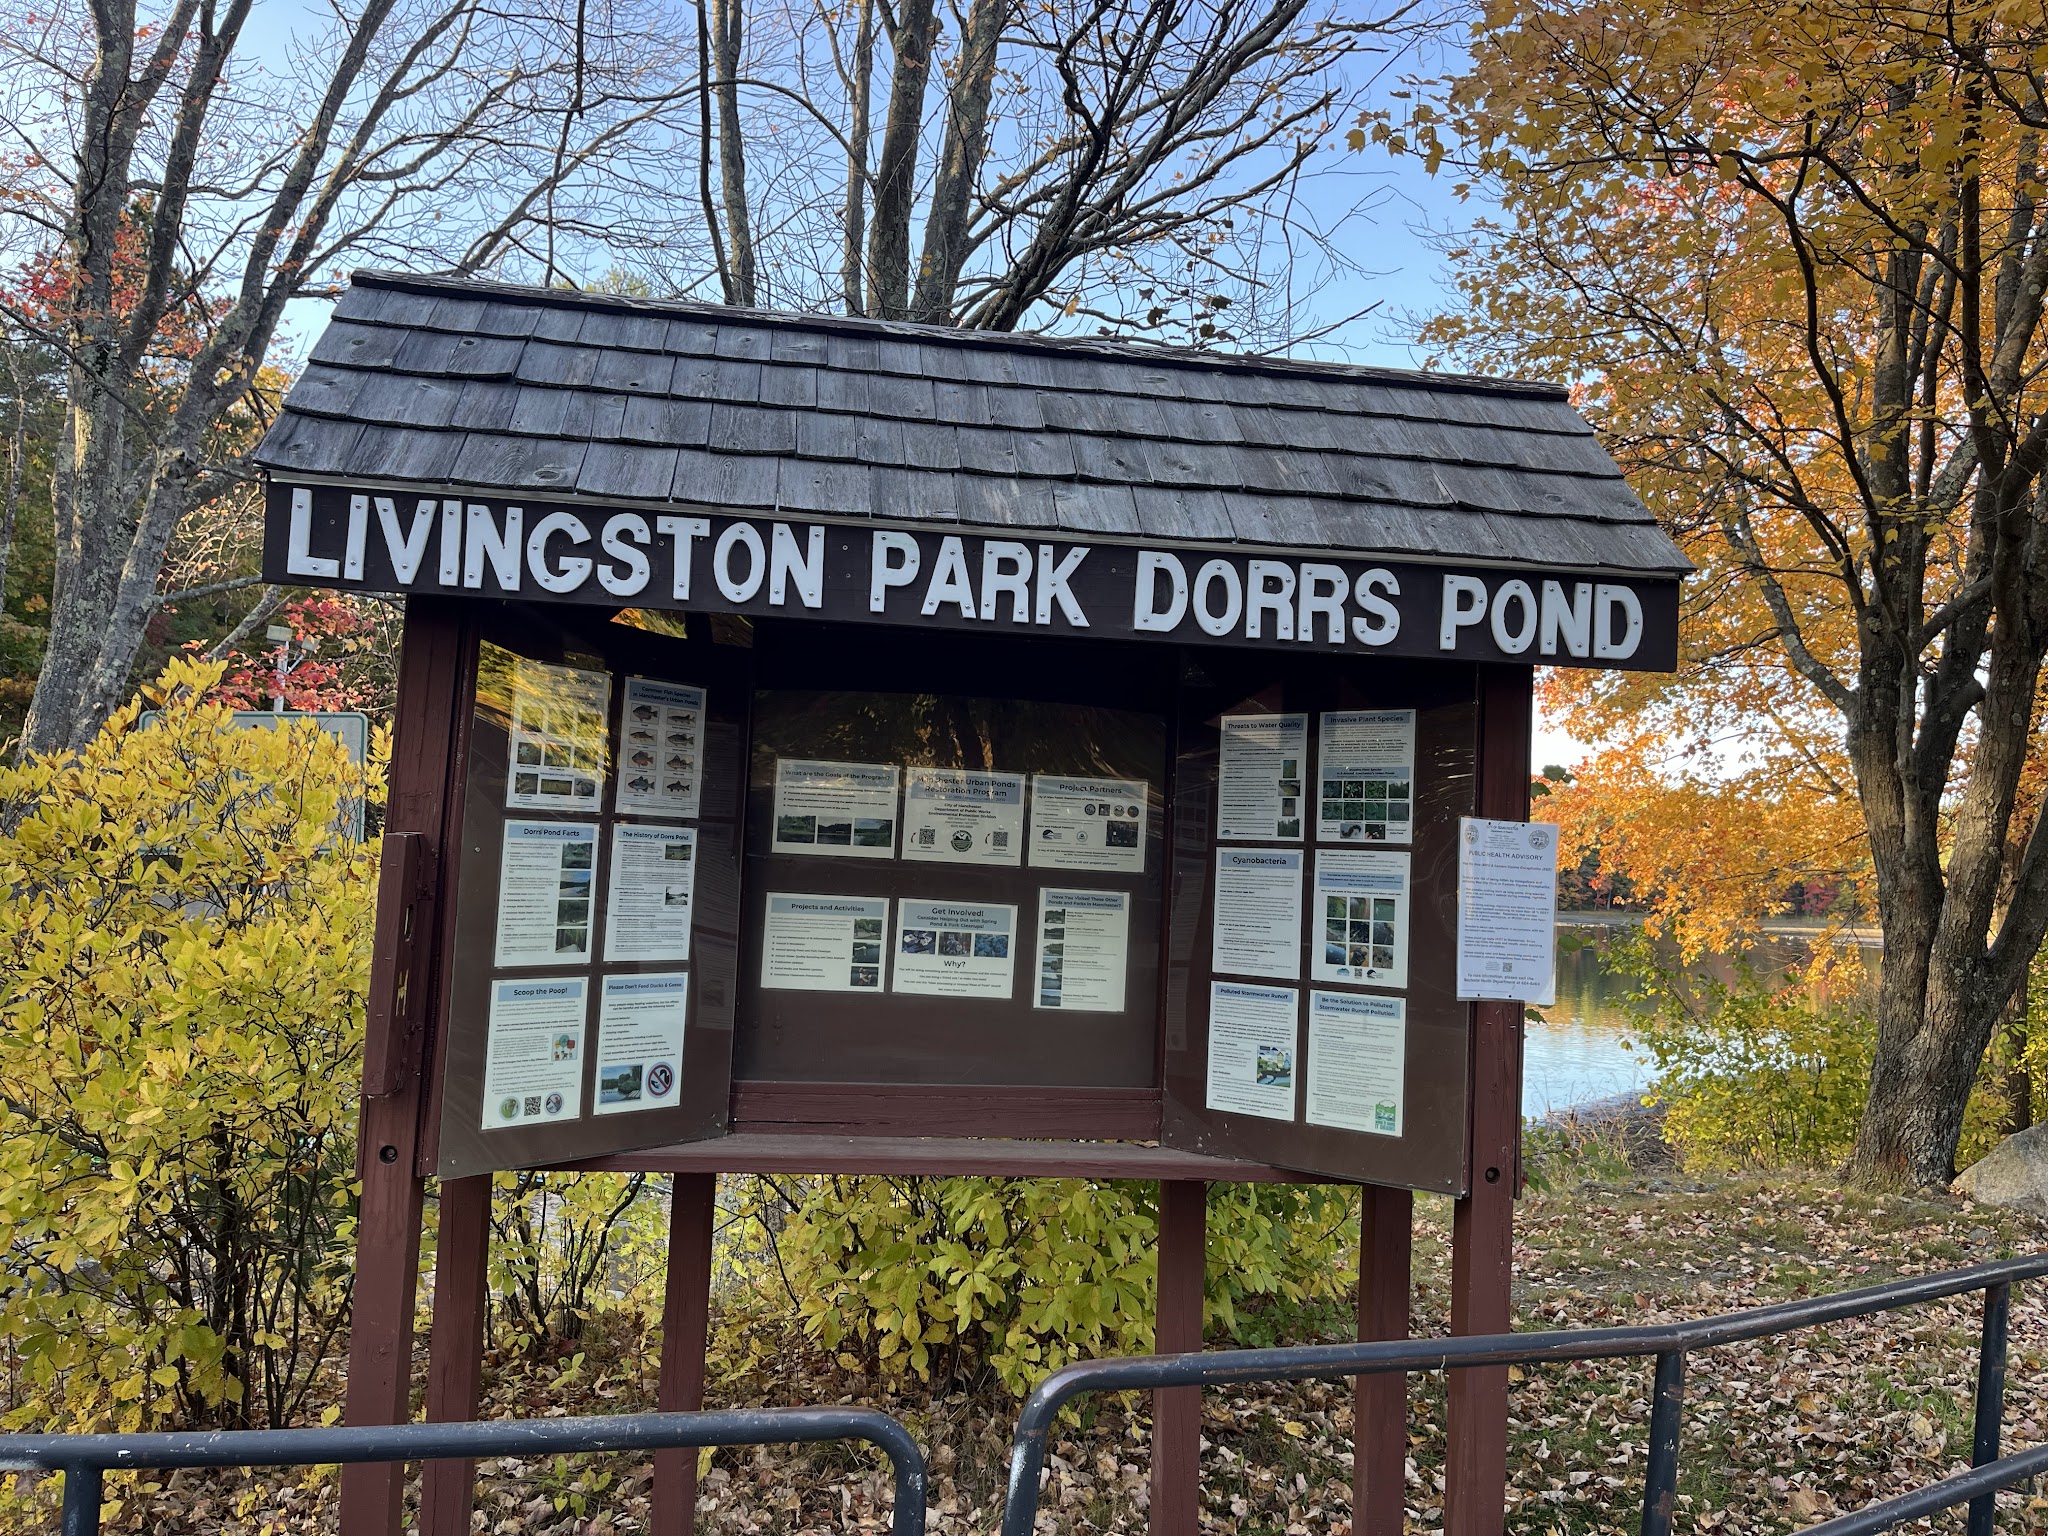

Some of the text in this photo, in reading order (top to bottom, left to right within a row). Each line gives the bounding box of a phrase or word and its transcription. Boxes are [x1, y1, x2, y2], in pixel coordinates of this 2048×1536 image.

[286, 487, 1644, 661] LIVINGSTON PARK DORRS POND
[1233, 856, 1287, 866] Cyanobacteria
[948, 909, 984, 917] Involved!
